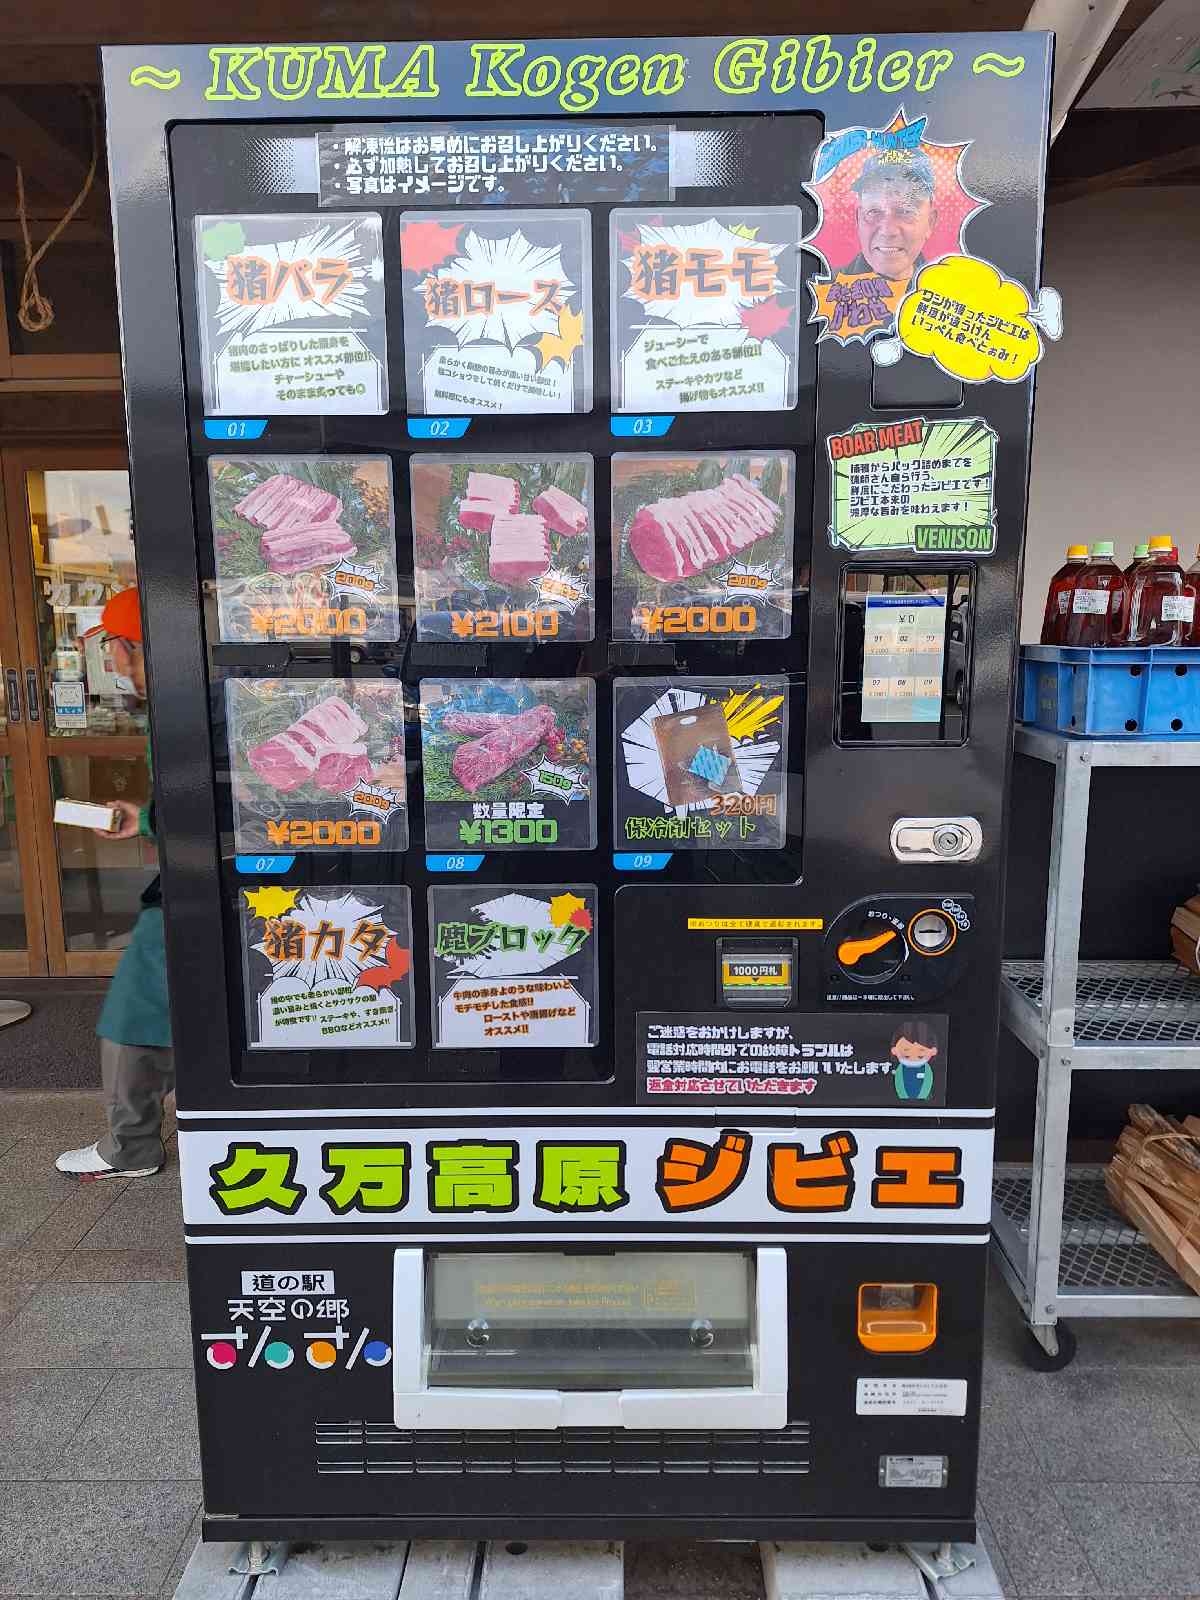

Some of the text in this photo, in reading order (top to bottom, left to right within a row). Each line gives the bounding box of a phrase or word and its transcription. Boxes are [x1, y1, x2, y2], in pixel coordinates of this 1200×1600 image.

[204, 45, 439, 101] KUMA
[465, 43, 686, 112] Kogen
[713, 35, 953, 95] Gibier
[633, 245, 779, 300] 猪モモ
[425, 278, 562, 319] 猪ロース
[644, 334, 709, 352] ジューシーで
[274, 368, 345, 385] チャーシューや
[655, 368, 744, 391] ステーキやカツなど
[227, 421, 246, 437] 01
[430, 420, 450, 436] 02
[633, 418, 653, 434] 03
[830, 420, 923, 460] BOAR MEAT
[850, 495, 910, 506] ジビエ本来の
[916, 527, 991, 549] VENISON
[250, 607, 367, 636] ¥2000
[451, 609, 560, 638] ¥2100
[642, 606, 757, 633] ¥2000
[472, 801, 545, 819] 数量限定
[709, 793, 777, 817] 320円
[265, 819, 382, 847] ¥2000
[459, 819, 558, 845] ¥1300
[625, 816, 756, 840] 保冷剤セット
[255, 857, 275, 872] 07
[446, 856, 465, 870] 08
[633, 855, 652, 867] 09
[263, 918, 389, 962] 猪カタ
[733, 965, 777, 976] 1000円札
[252, 1274, 325, 1291] 道の駅
[227, 1297, 350, 1323] 天空の郷
